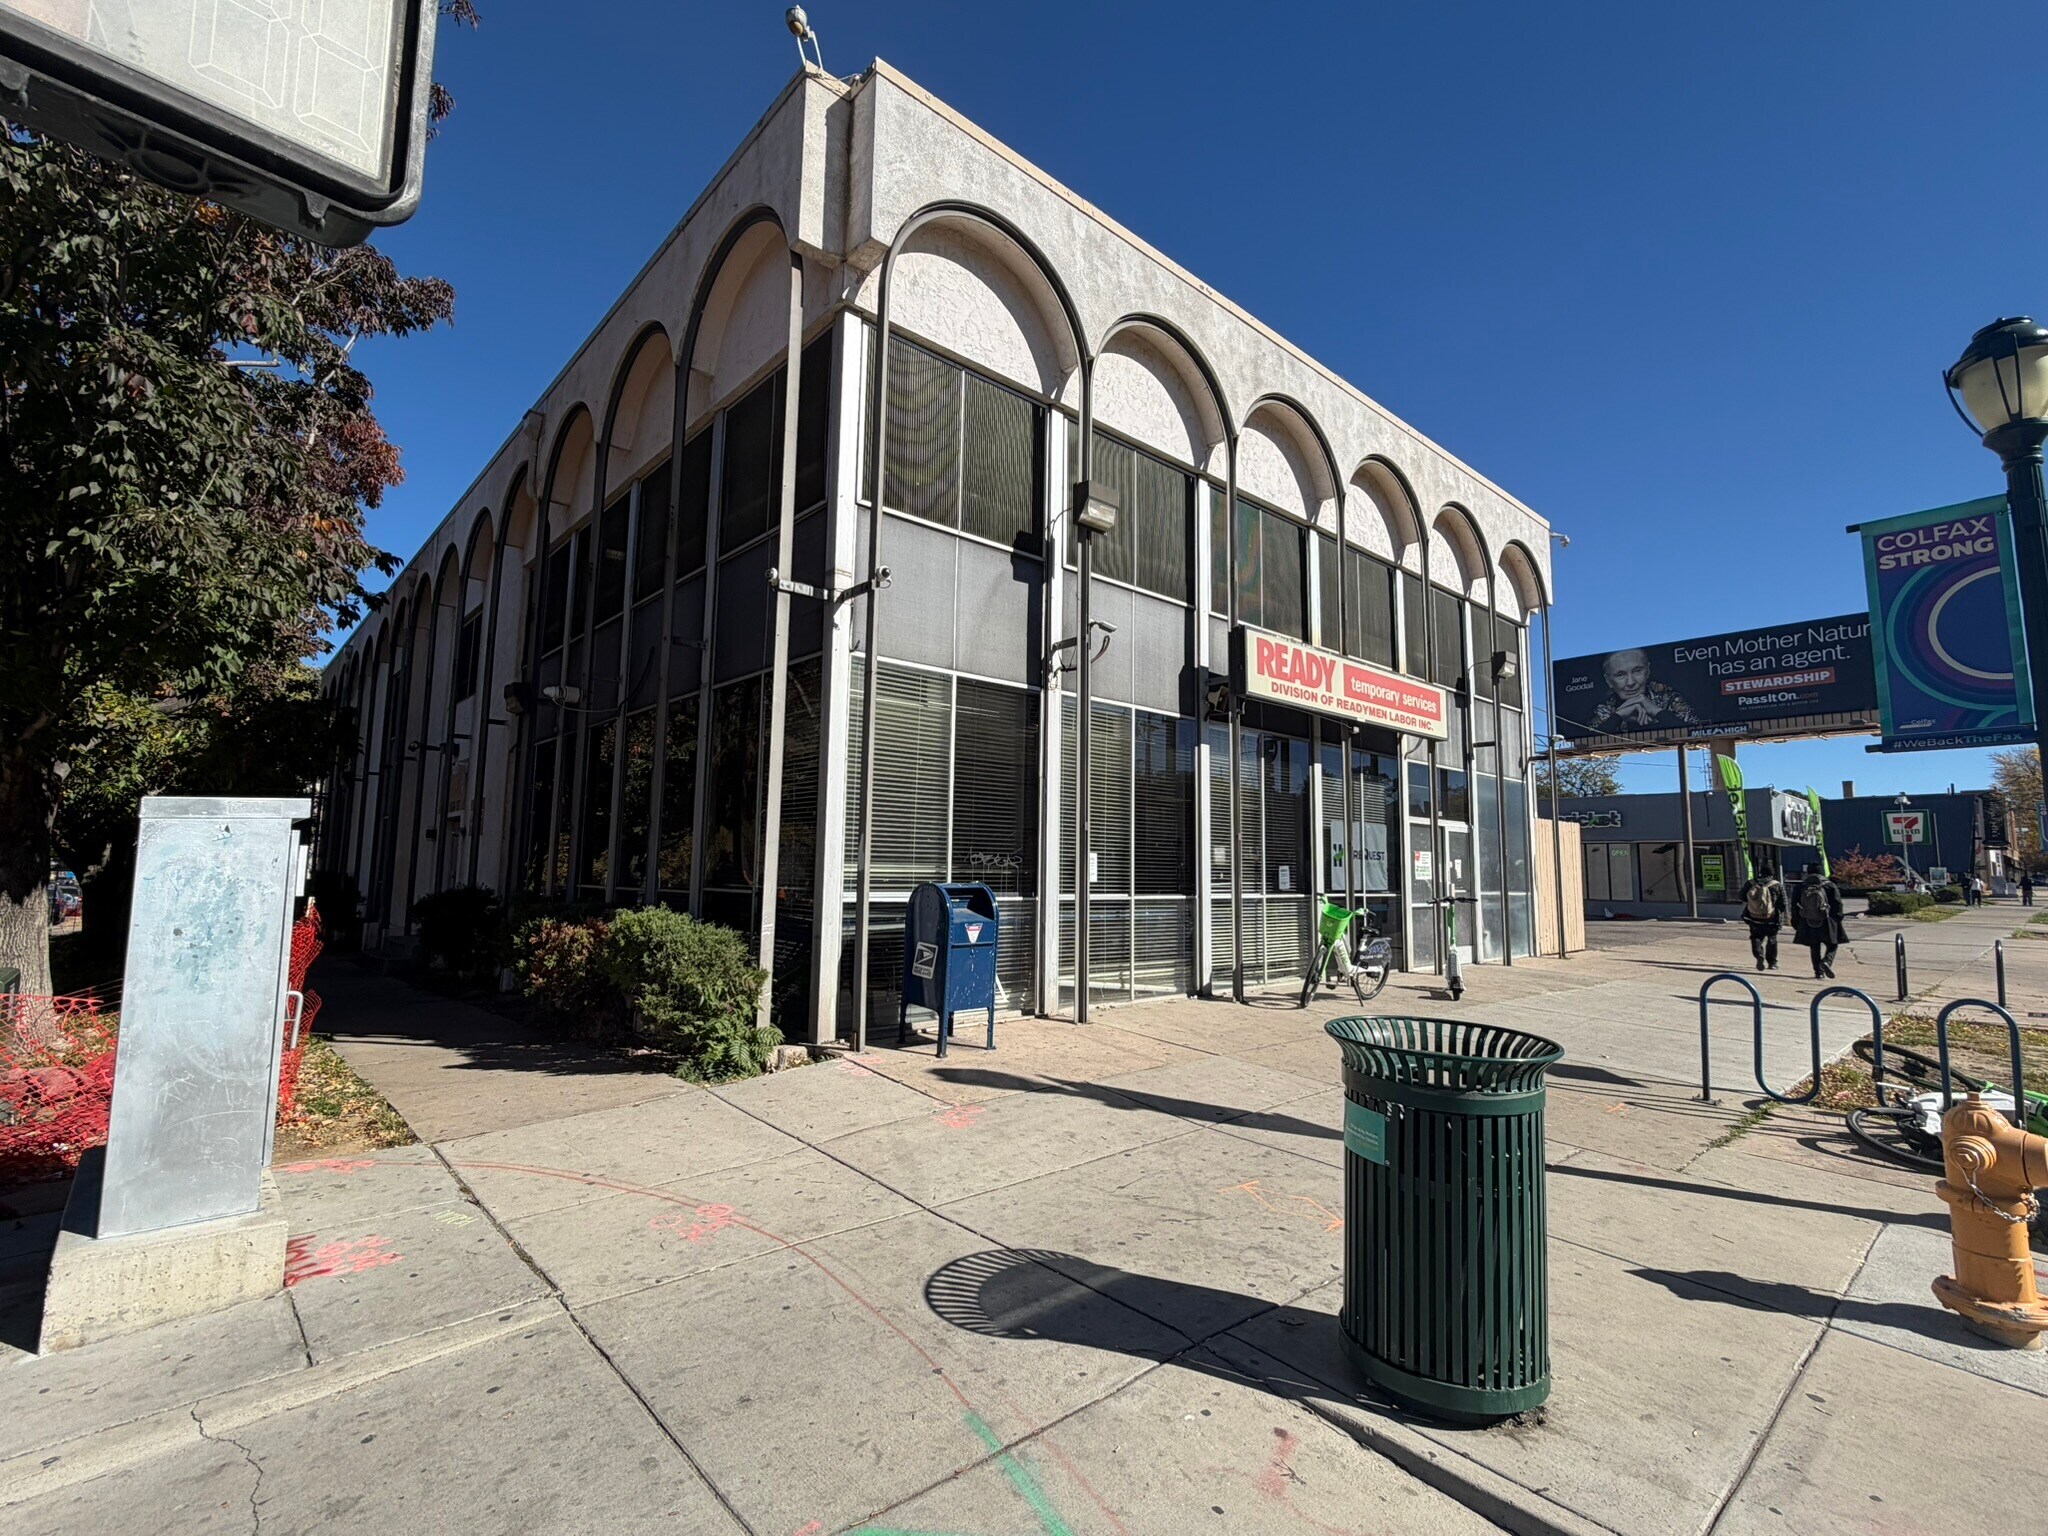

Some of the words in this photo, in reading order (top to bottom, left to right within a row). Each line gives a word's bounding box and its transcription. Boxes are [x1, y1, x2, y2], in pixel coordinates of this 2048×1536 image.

[1877, 517, 1990, 552] COLFAX
[1879, 537, 1995, 570] STRONG
[1674, 645, 1720, 663] Even
[1725, 632, 1803, 656] Mother
[1807, 623, 1871, 644] Natur
[1256, 637, 1336, 693] READY
[1709, 658, 1746, 676] has
[1750, 656, 1776, 671] an
[1781, 644, 1851, 668] agent.
[1565, 681, 1595, 692] Goodall
[1571, 675, 1588, 684] Jane
[1725, 670, 1831, 692] STEWARDSHIP
[1271, 682, 1319, 703] DIVISION
[1320, 694, 1334, 707] OF
[1336, 698, 1388, 721] READYMEN
[1389, 711, 1417, 727] LABOR
[1418, 719, 1434, 731] INC.
[1350, 677, 1401, 706] temporary
[1402, 694, 1437, 713] services
[1691, 729, 1712, 737] MILE
[1724, 725, 1747, 734] HIGH
[1893, 732, 2022, 749] #WeBackTheFax
[1558, 810, 1621, 828] ricket
[1892, 816, 1919, 842] 7
